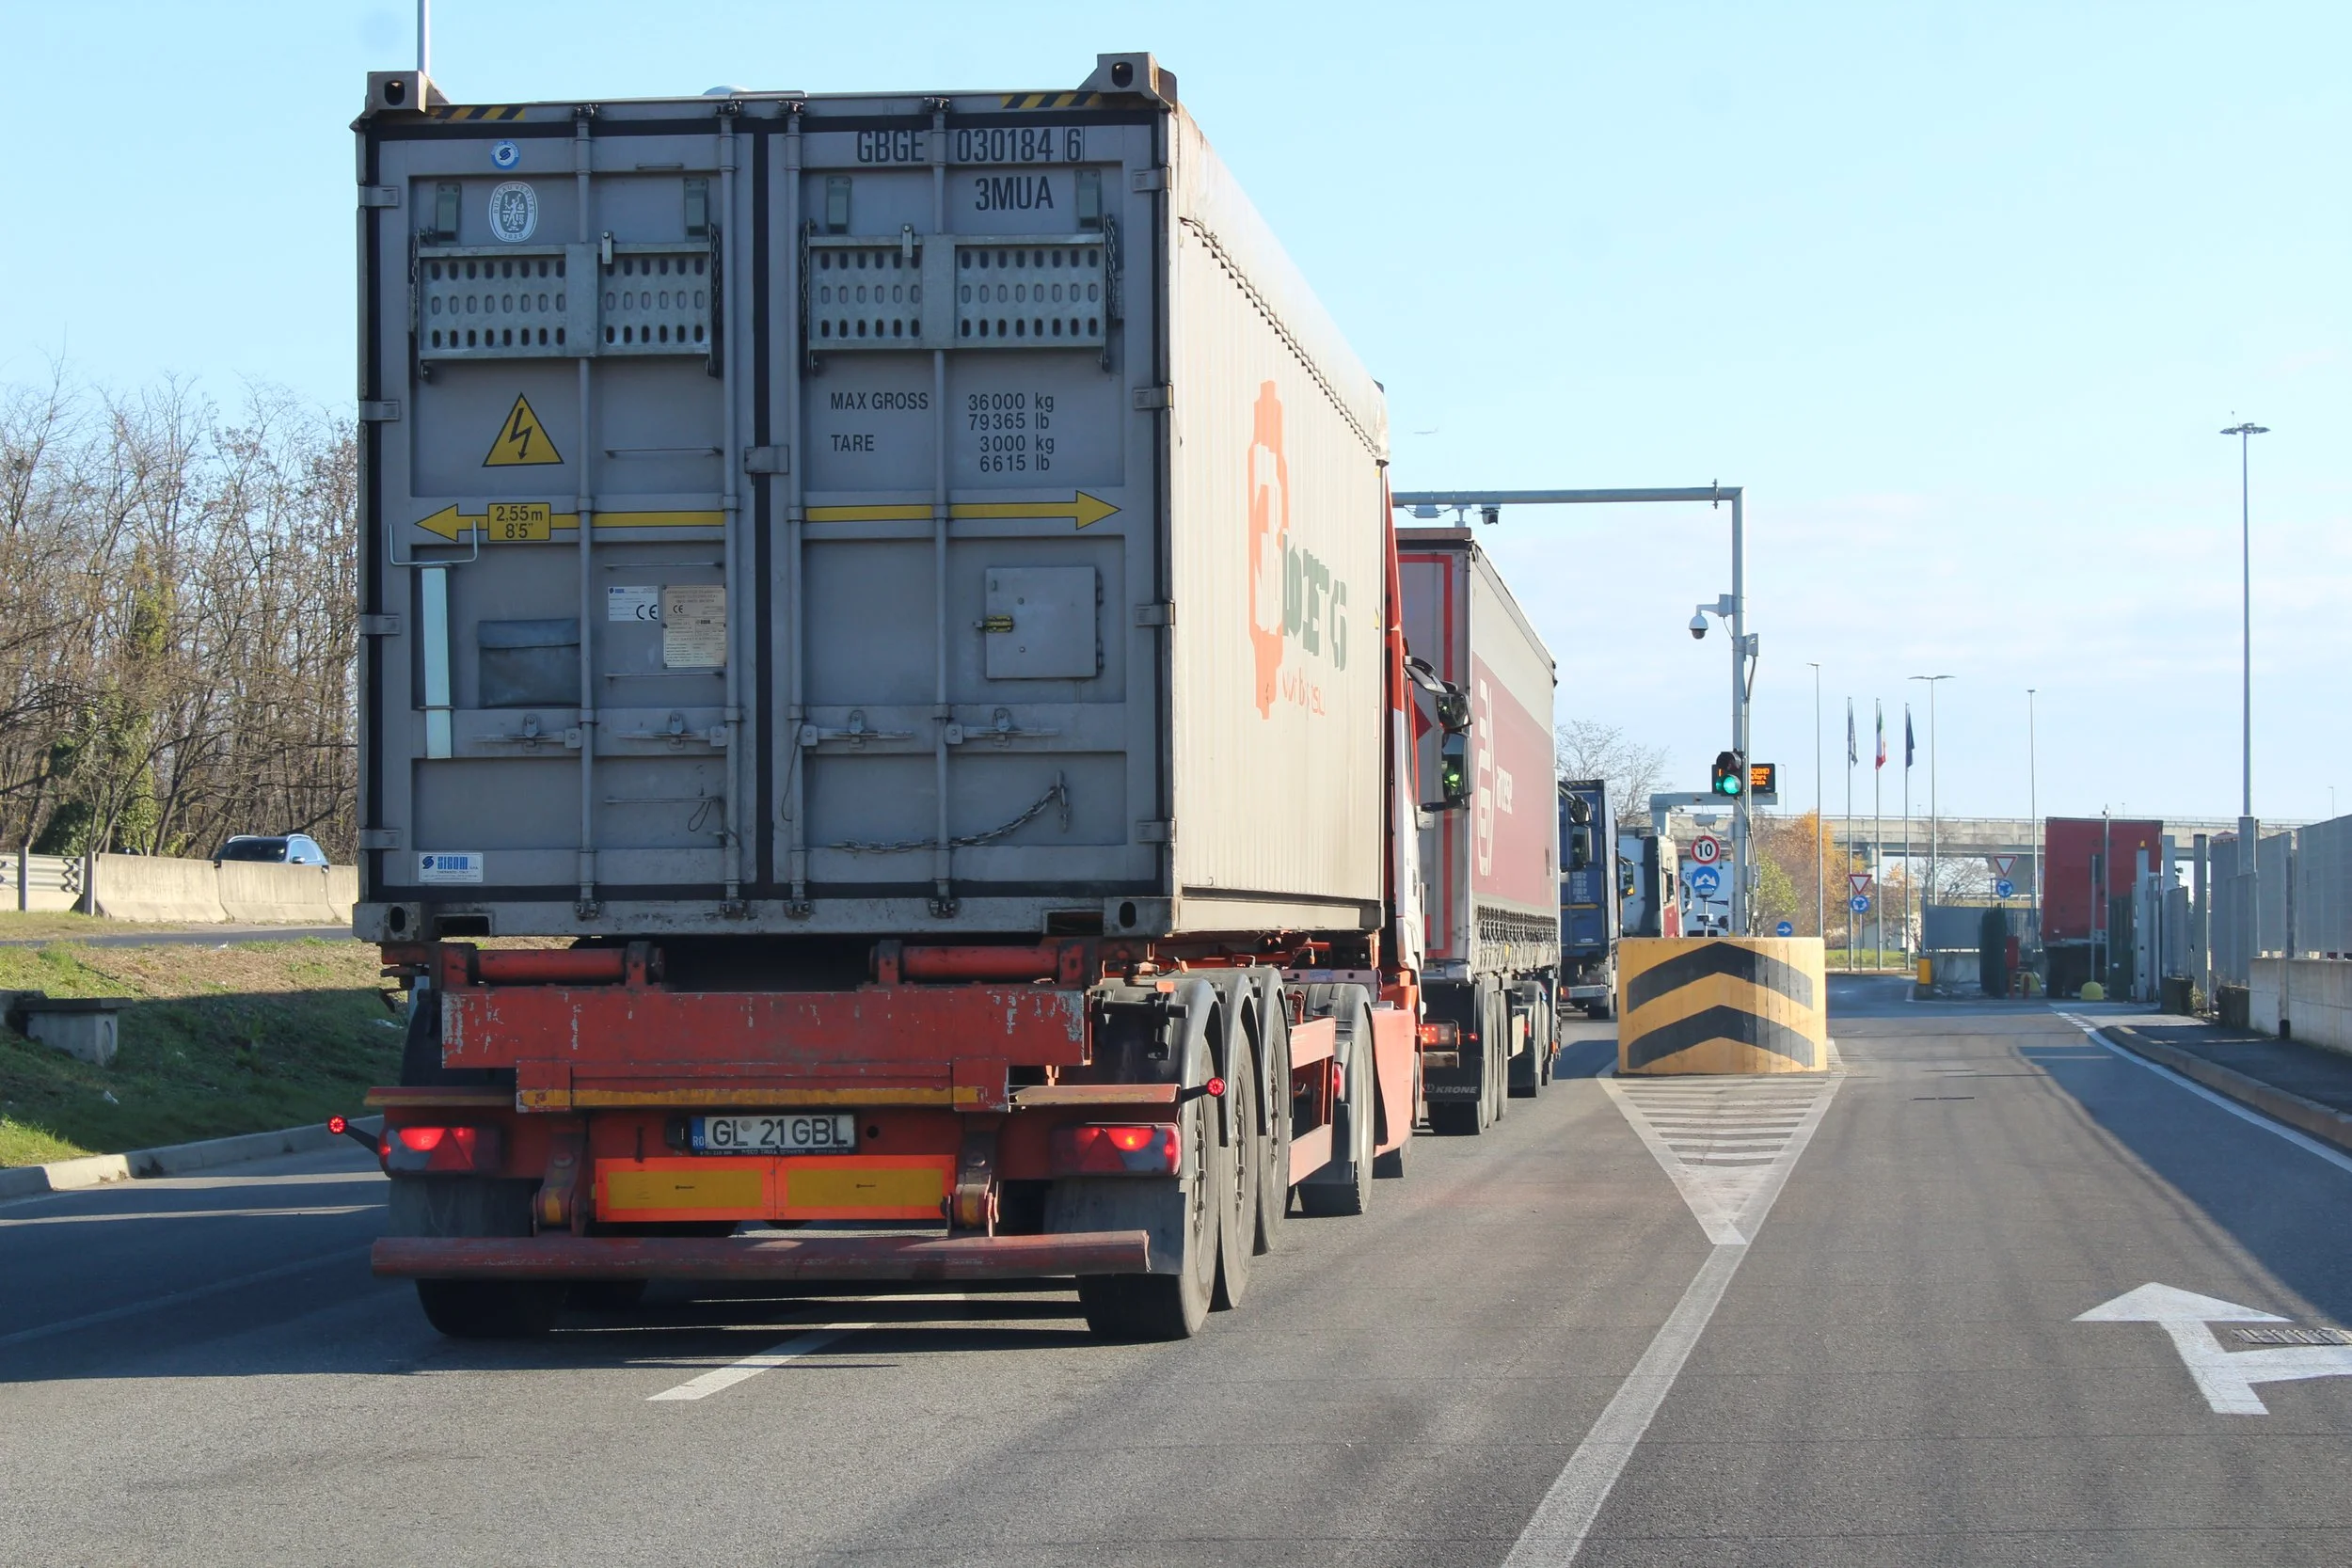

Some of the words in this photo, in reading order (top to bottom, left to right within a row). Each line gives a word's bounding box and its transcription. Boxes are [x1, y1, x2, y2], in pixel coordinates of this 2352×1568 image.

[856, 129, 925, 163] GBGE
[956, 128, 1054, 163] 030184
[1066, 127, 1082, 162] 6
[975, 176, 1054, 212] 3MUA
[830, 391, 867, 410] MAX
[871, 391, 930, 410] GROSS
[1034, 391, 1055, 414] kg
[1035, 412, 1051, 430] lb
[830, 434, 875, 452] TARE
[1034, 434, 1055, 455] kg
[1035, 453, 1051, 471] lb
[496, 505, 529, 522] 2,55
[531, 510, 543, 521] m
[1697, 843, 1713, 858] 10
[692, 1135, 705, 1147] RO
[712, 1119, 749, 1147] GL
[759, 1118, 786, 1146] 21
[791, 1117, 849, 1146] GBL
